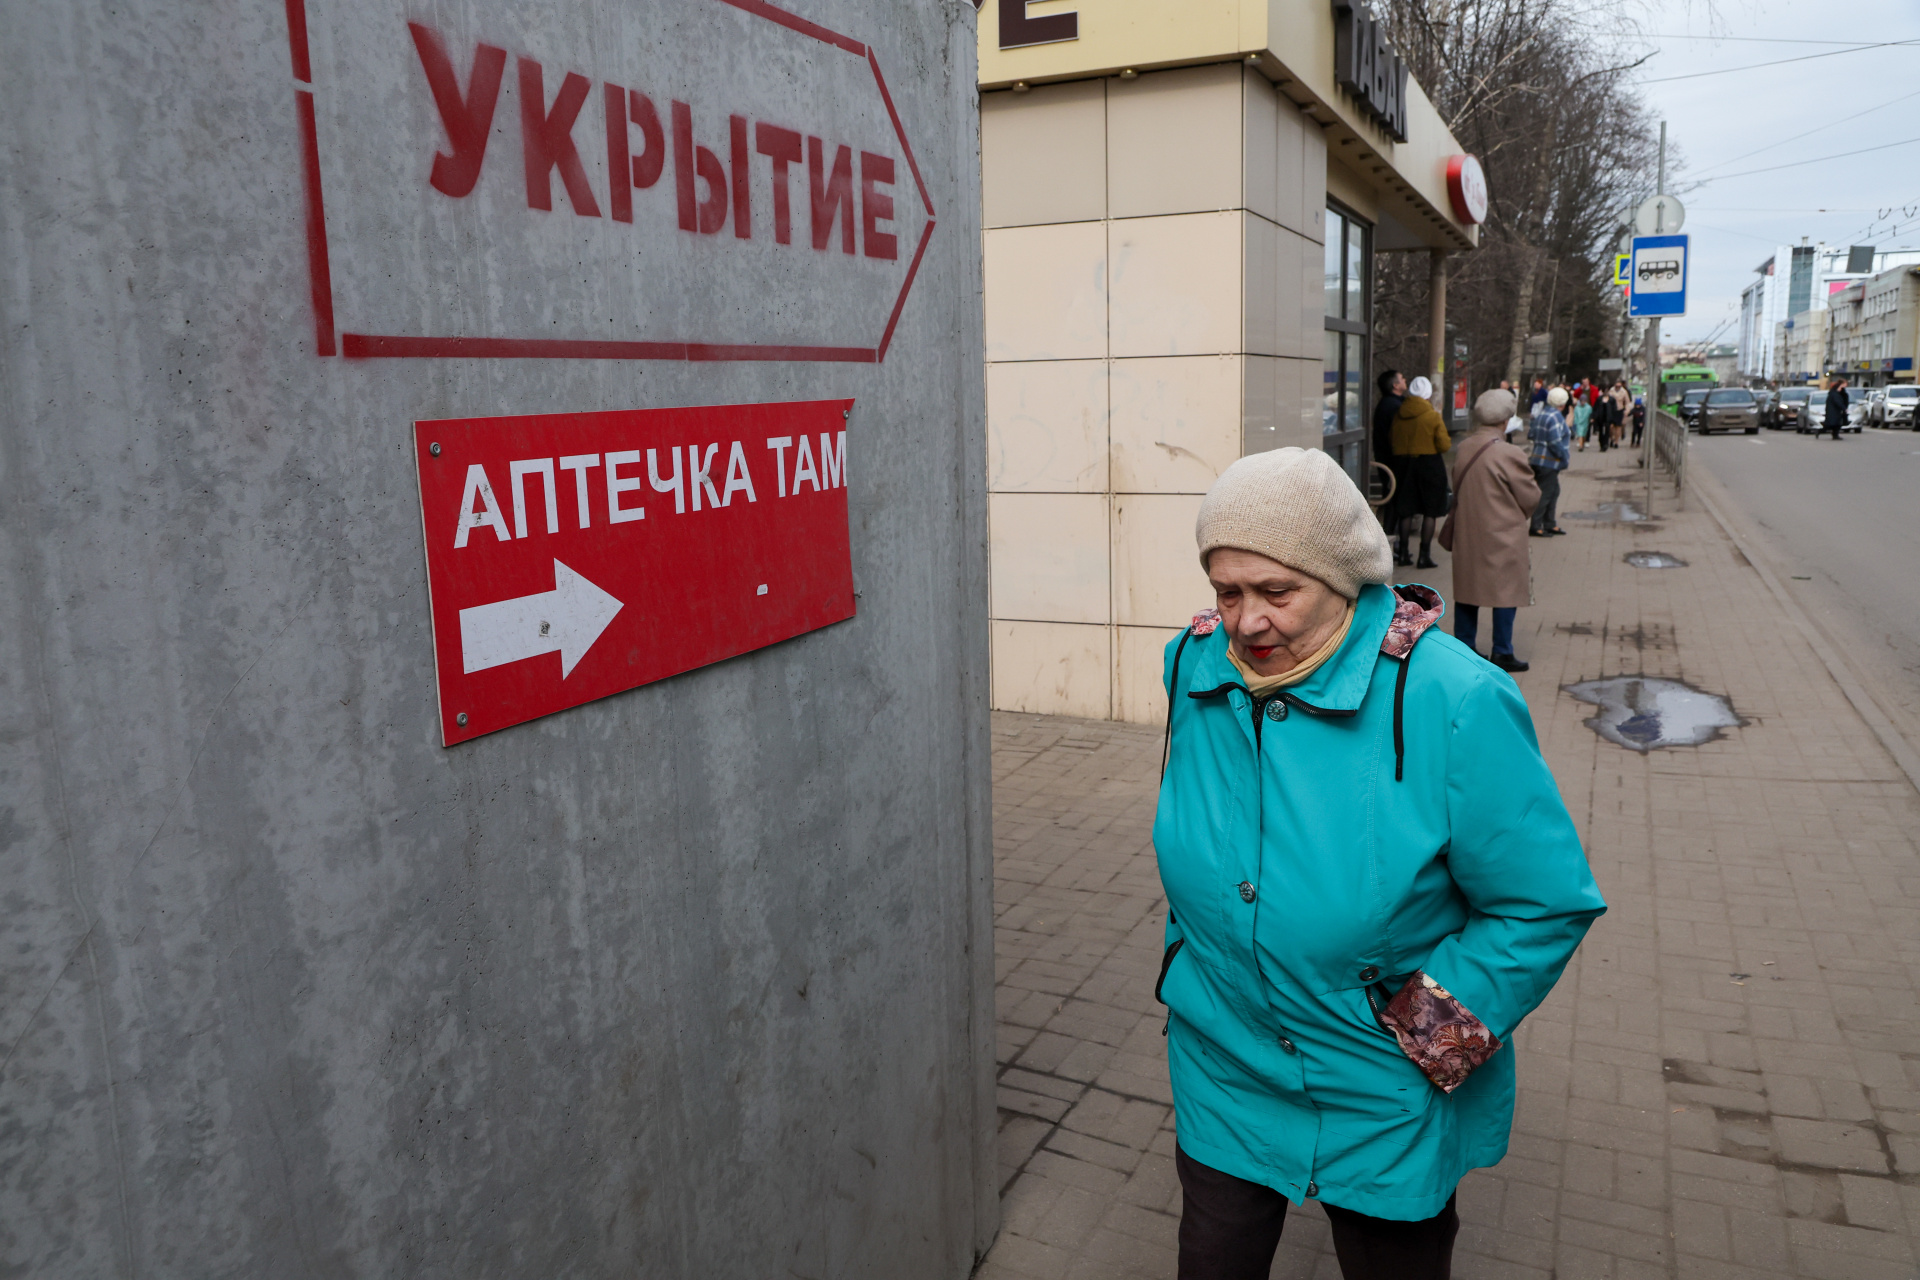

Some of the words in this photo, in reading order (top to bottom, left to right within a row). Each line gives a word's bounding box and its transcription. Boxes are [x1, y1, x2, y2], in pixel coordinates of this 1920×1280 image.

[407, 20, 898, 261] УКРЫТИЕ
[1332, 0, 1410, 143] ТАБАК
[453, 440, 758, 549] АПТЕЧКА
[766, 430, 848, 498] ТАМ
